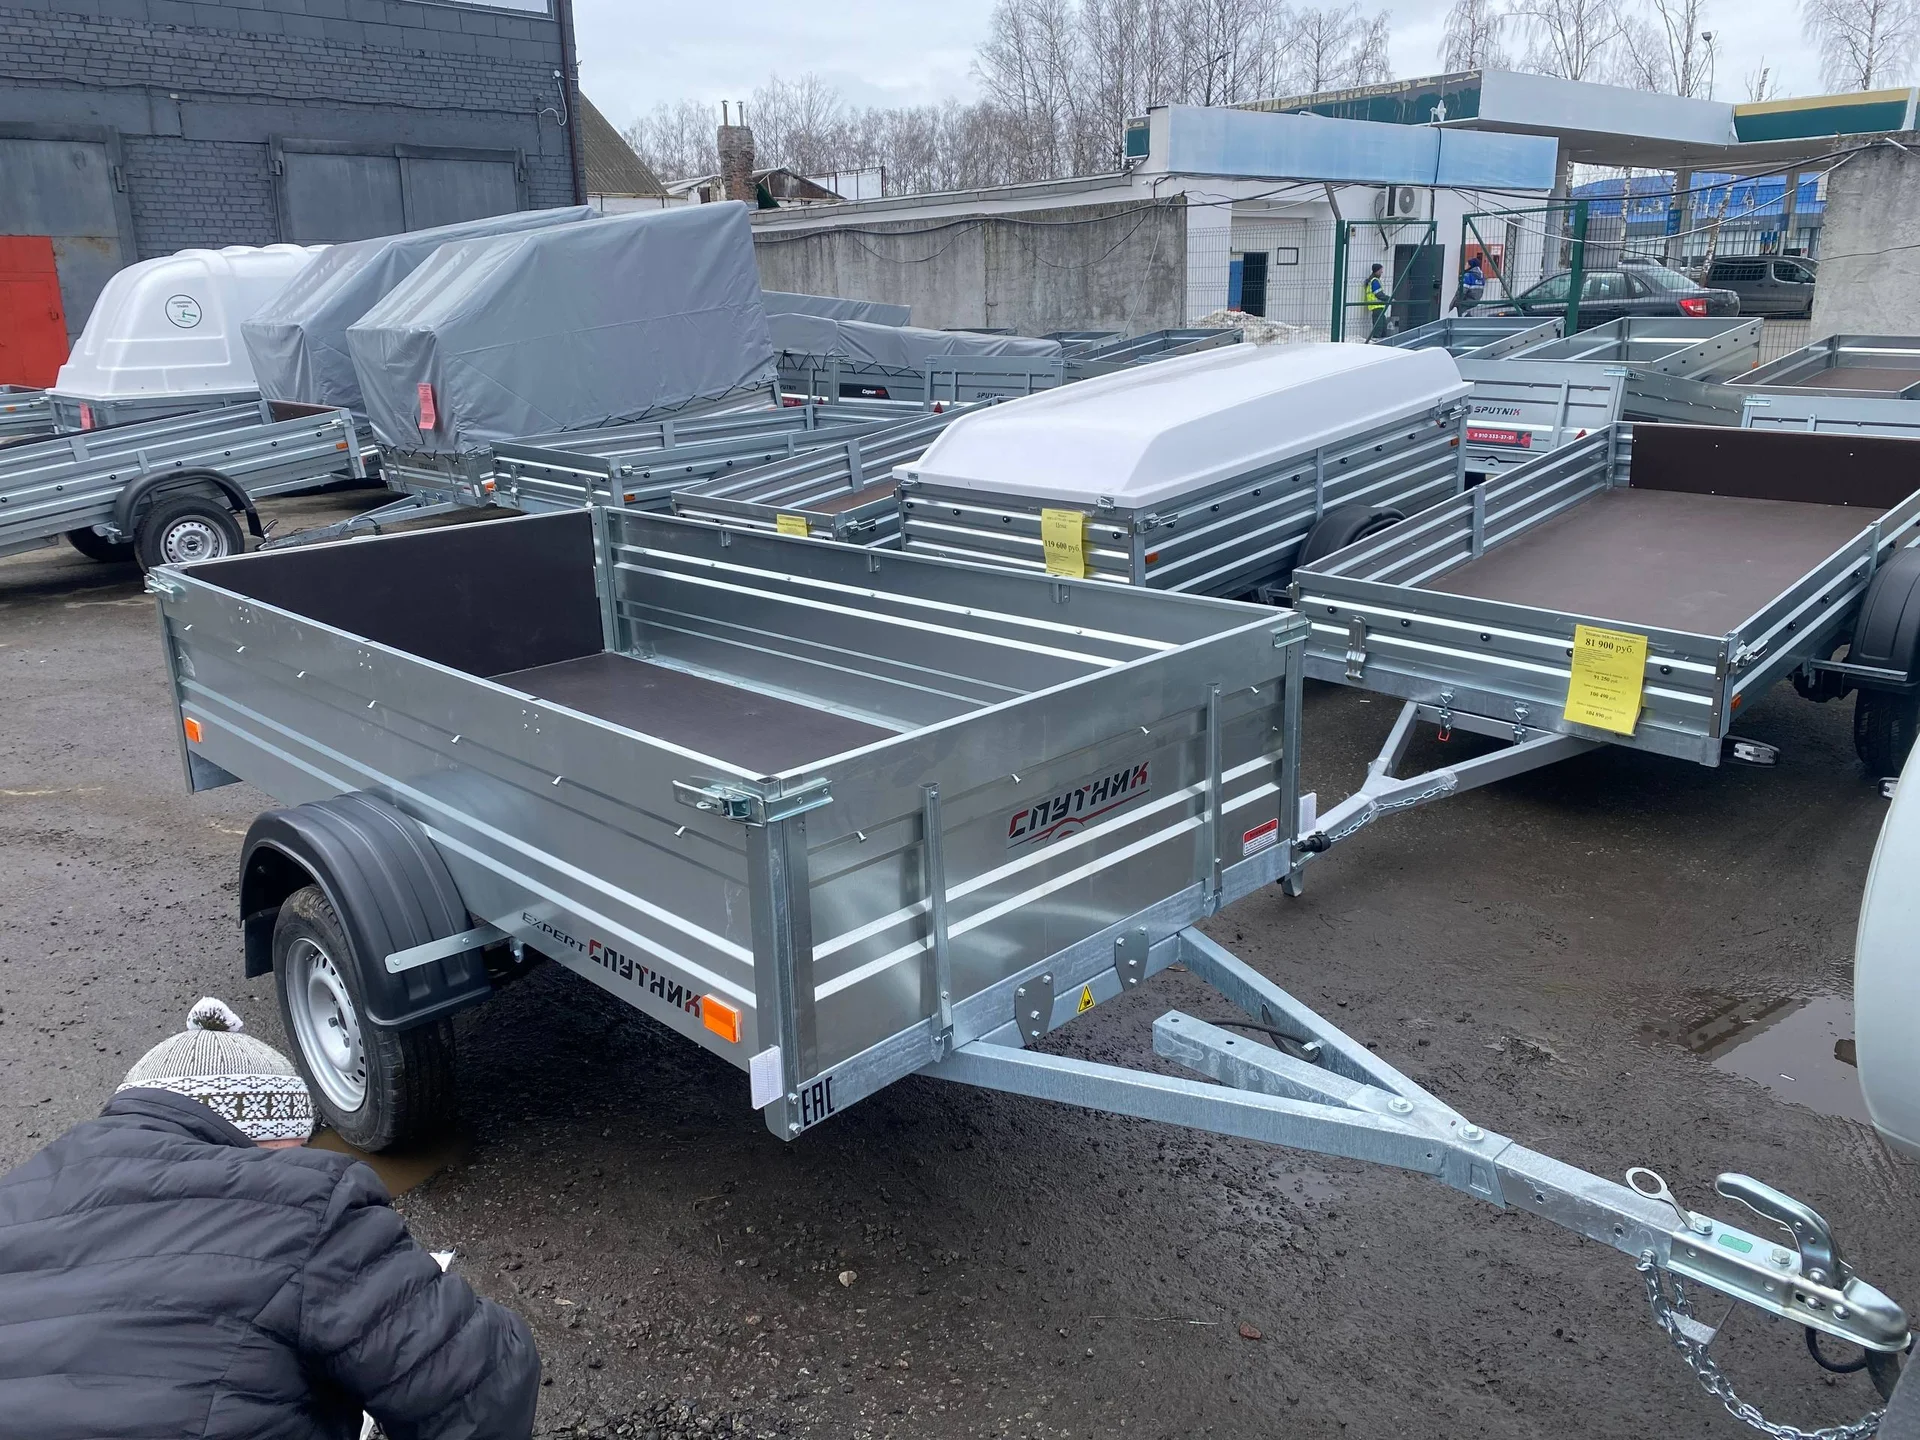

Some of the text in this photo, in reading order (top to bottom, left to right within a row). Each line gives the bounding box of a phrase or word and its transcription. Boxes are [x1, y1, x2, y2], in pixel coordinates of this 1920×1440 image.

[1474, 405, 1521, 416] SPUTNIK
[1045, 540, 1055, 548] 119
[1585, 638, 1634, 654] 81 900 руб.
[1008, 761, 1150, 839] СПУТНИК
[521, 911, 586, 953] EXPERT
[588, 938, 702, 1019] СПУТНИК
